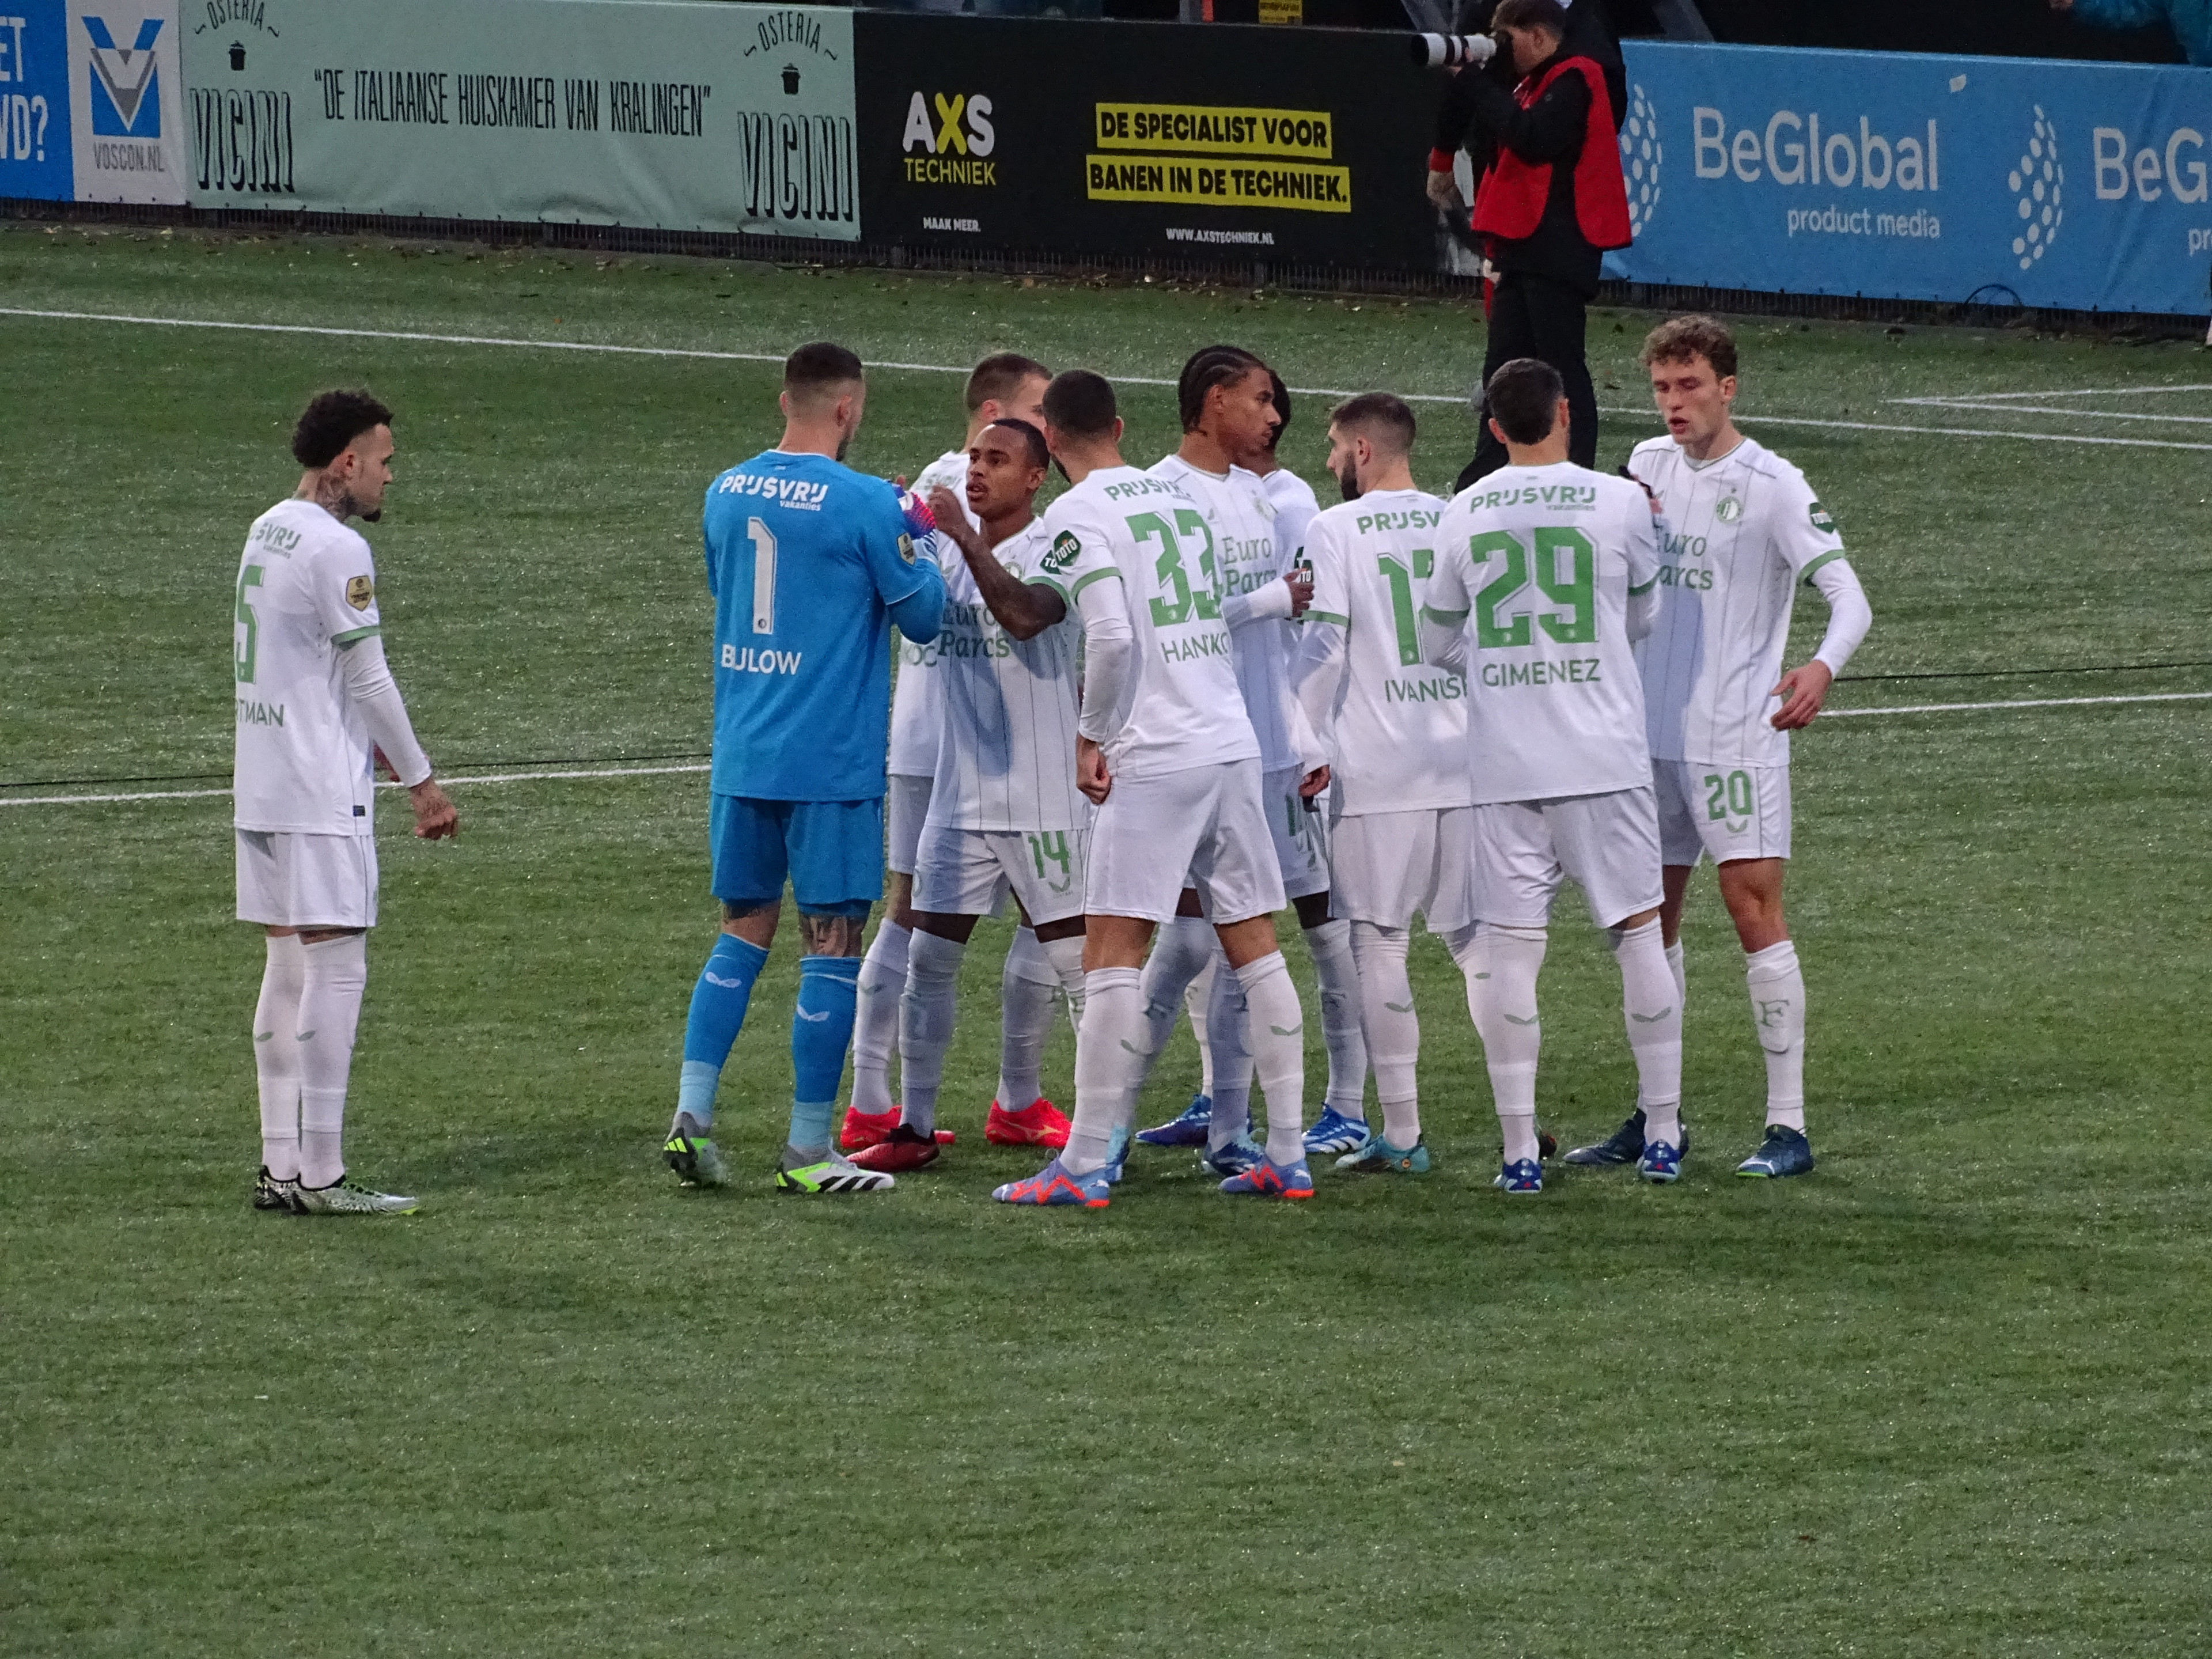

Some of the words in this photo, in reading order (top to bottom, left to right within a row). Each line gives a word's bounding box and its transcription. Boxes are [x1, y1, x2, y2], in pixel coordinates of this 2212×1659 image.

[757, 11, 821, 53] OSTERIA
[354, 70, 449, 124] ITALIAANSE
[458, 74, 556, 129] HUISKAMER
[565, 78, 599, 131] VAN
[611, 81, 711, 137] KRALINGEN"
[902, 91, 996, 157] AXS
[1101, 112, 1130, 139] DE
[1134, 112, 1257, 143] SPECIALIST
[1264, 118, 1327, 147] VOOR
[93, 142, 165, 172] VOSCON.NL
[737, 112, 854, 221] VICINI
[1693, 107, 1939, 192] BeGlobal
[904, 157, 997, 187] TECHNIEK
[1090, 164, 1164, 192] BANEN
[1169, 166, 1192, 194] IN
[1198, 169, 1226, 196] DE
[1231, 169, 1349, 203] TECHNIEK.
[923, 217, 951, 230] MAAK
[1165, 228, 1275, 245] WWW.AXSTECHNIEK.NL
[1787, 204, 1872, 238] product
[1877, 210, 1940, 240] media
[1055, 538, 1078, 562] TOTO
[1123, 508, 1224, 628] 33
[1222, 536, 1272, 565] Euro
[747, 516, 777, 635] 1
[1469, 525, 1600, 649] 29
[1659, 565, 1713, 590] arcs
[237, 565, 265, 684] 5
[938, 629, 1010, 658] Parcs
[1482, 658, 1601, 687] GIMENEZ
[237, 698, 284, 728] TMAN
[1704, 770, 1753, 821] 20
[1028, 830, 1071, 879] 14
